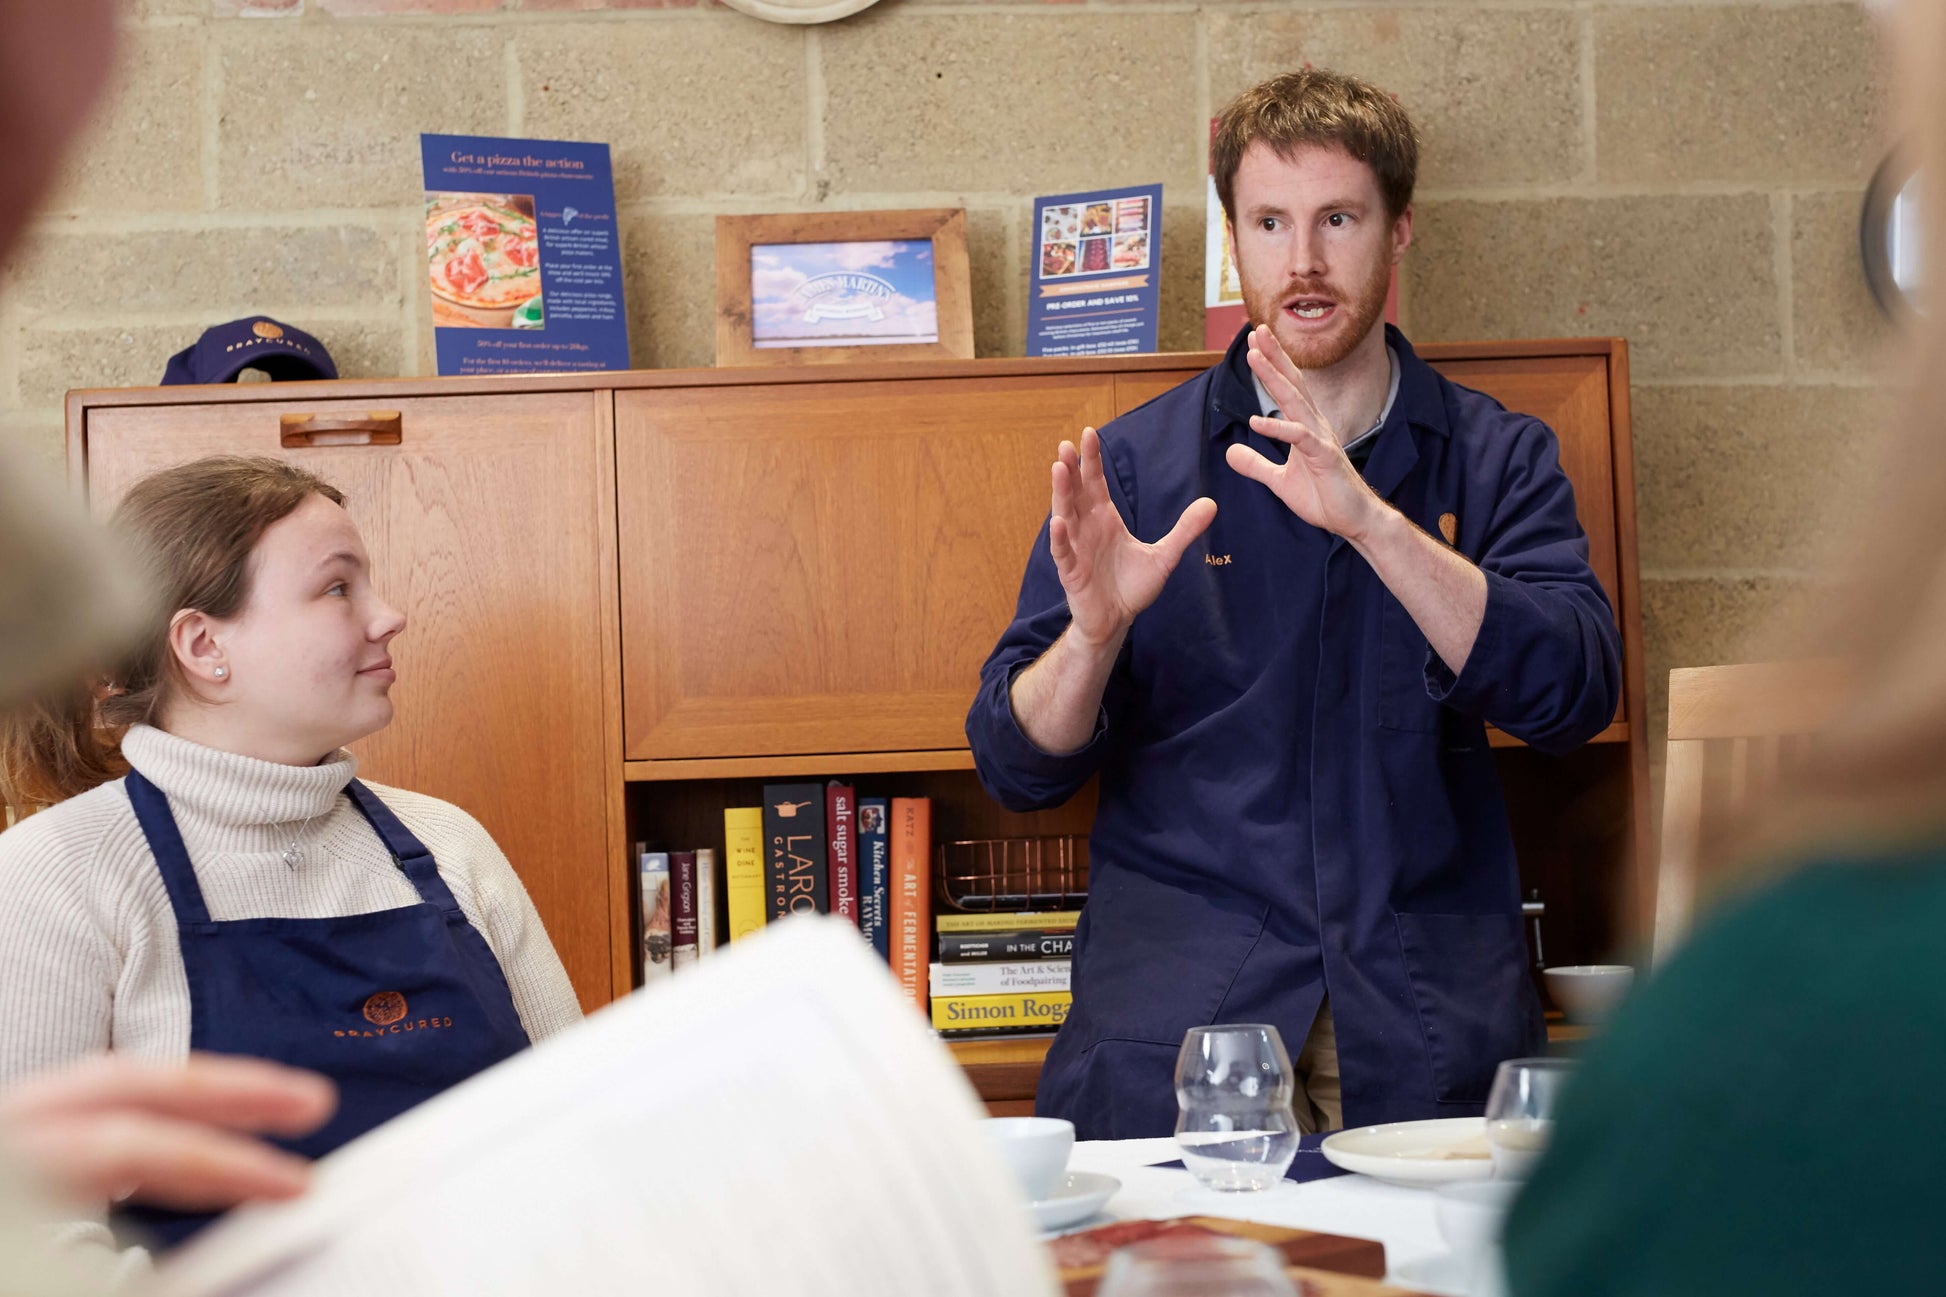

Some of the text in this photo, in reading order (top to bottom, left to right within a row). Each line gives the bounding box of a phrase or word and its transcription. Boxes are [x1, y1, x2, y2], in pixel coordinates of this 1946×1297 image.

[450, 151, 584, 170] Get a pizza the action
[1046, 299, 1086, 311] PRE-ORDER
[1086, 298, 1104, 307] AND
[1104, 295, 1125, 305] SAVE
[1205, 553, 1232, 566] Alex
[905, 807, 914, 838] KATZ
[832, 796, 854, 915] salt sugar smoke
[681, 862, 691, 881] Jane
[787, 835, 816, 915] LARO
[872, 840, 885, 927] Kitchen Secrets
[903, 873, 917, 897] ART
[680, 882, 692, 913] Grigson
[1006, 940, 1073, 954] IN THE CHA
[1000, 964, 1071, 976] The Art & Scien
[1000, 976, 1068, 988] of Foodpairing
[947, 998, 1071, 1022] Simon Roga
